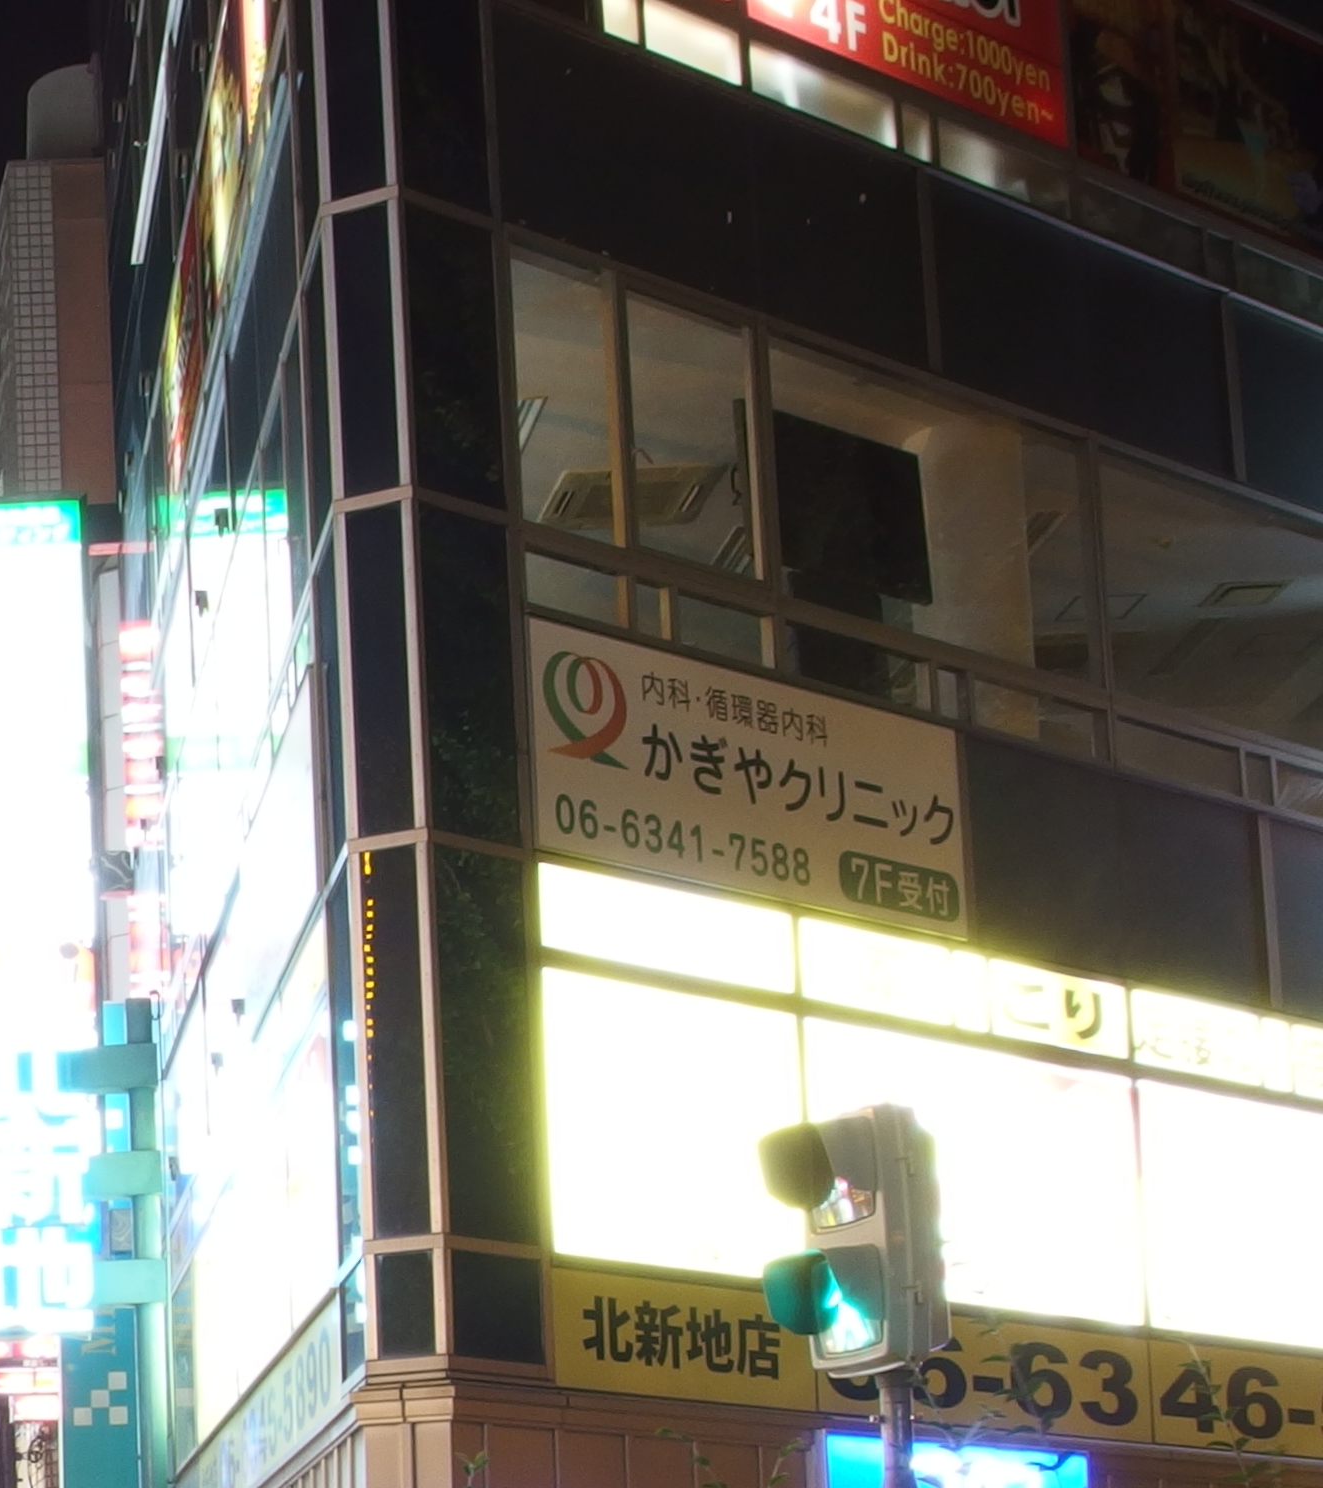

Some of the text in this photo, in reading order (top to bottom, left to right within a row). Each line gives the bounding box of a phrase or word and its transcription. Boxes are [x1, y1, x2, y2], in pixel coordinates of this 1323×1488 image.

[810, 0, 867, 51] 4F
[642, 722, 955, 846] かぎやクリニック
[555, 792, 812, 887] 06-6341-7588
[850, 856, 950, 918] 7F受付
[582, 1296, 781, 1382] 北新地店
